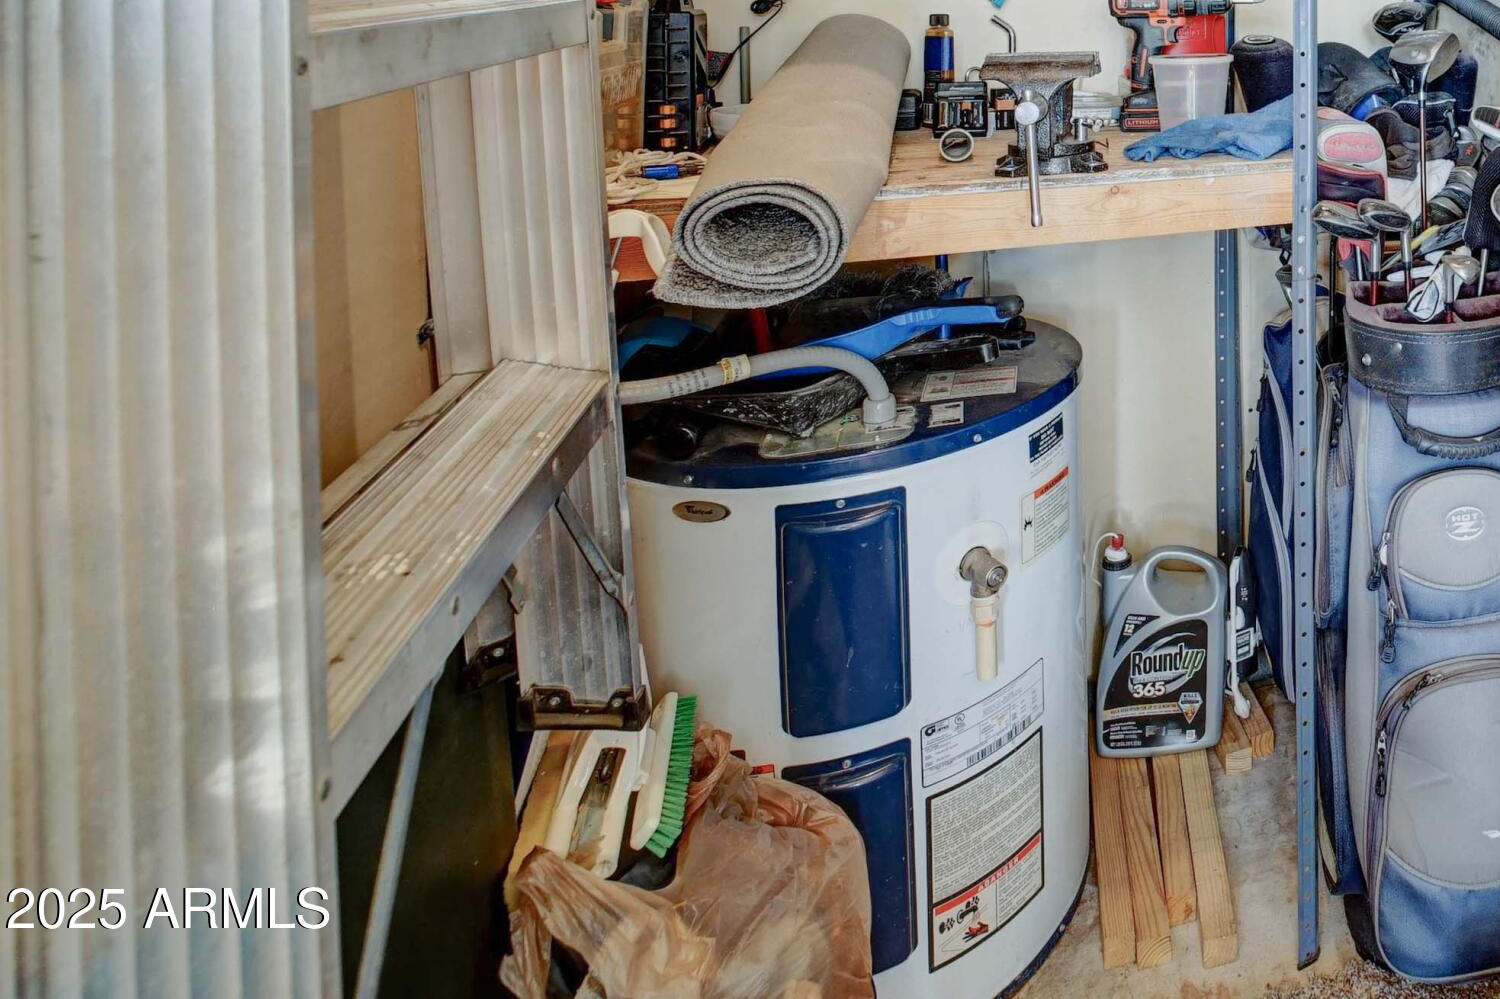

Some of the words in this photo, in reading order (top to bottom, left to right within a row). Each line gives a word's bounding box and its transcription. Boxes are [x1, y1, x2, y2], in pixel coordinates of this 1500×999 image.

[1451, 512, 1480, 523] HOT
[1123, 623, 1135, 634] 12
[1131, 643, 1206, 679] Roundup
[1132, 681, 1166, 698] 365
